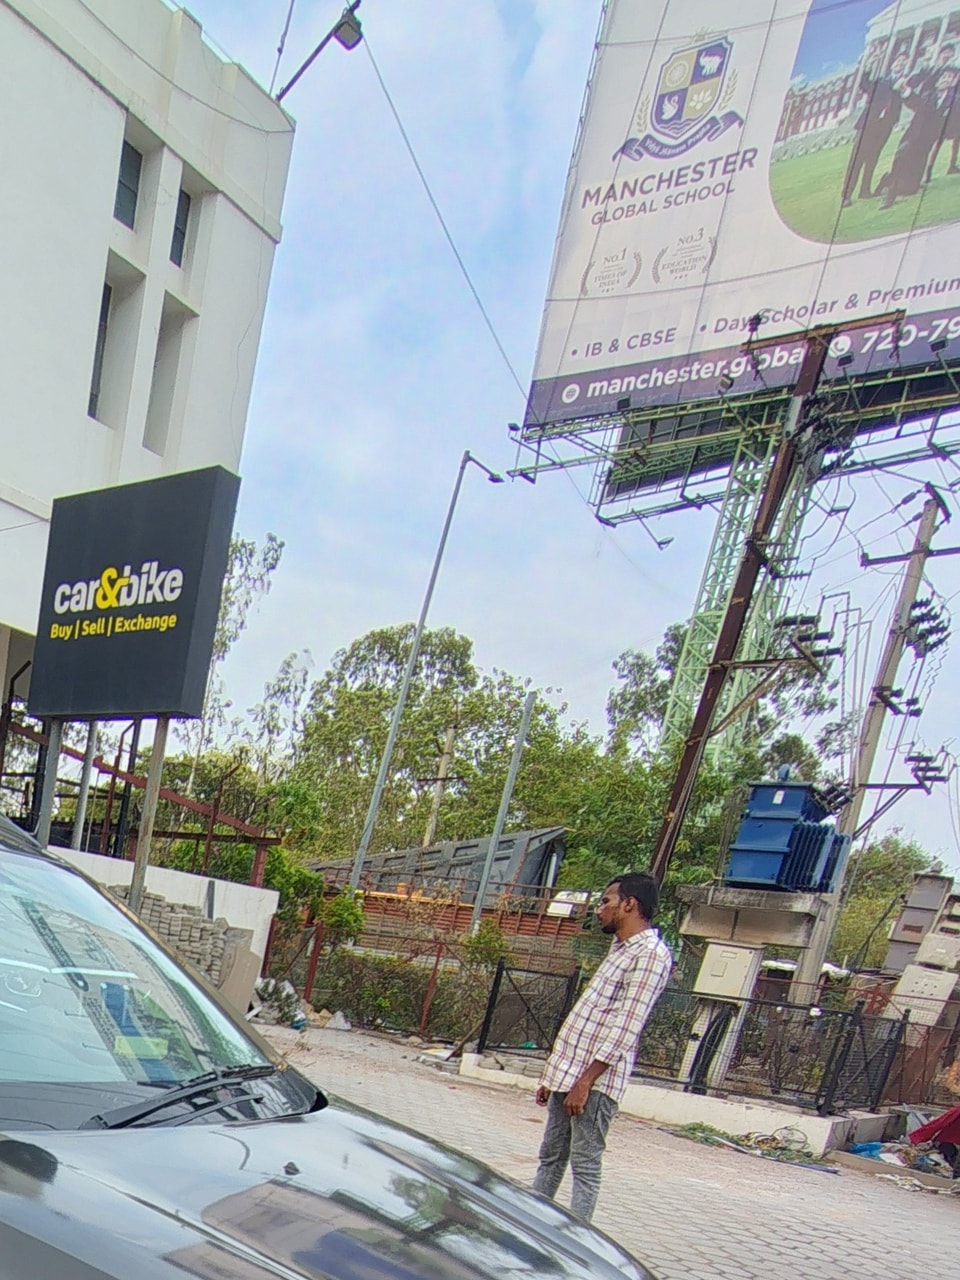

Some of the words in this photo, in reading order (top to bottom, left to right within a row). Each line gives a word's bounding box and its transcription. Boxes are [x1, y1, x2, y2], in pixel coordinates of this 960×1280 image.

[581, 147, 758, 209] MANCHESTER
[591, 200, 658, 226] GLOBAL
[662, 179, 735, 209] SCHOOL
[759, 298, 838, 325] Scholar
[844, 293, 858, 310] &
[585, 342, 602, 358] IB
[608, 338, 619, 353] &
[627, 327, 677, 350] CBSE
[53, 560, 184, 615] car&bike
[50, 623, 73, 641] Buy
[81, 616, 105, 637] Sell
[114, 613, 177, 633] Exchange
